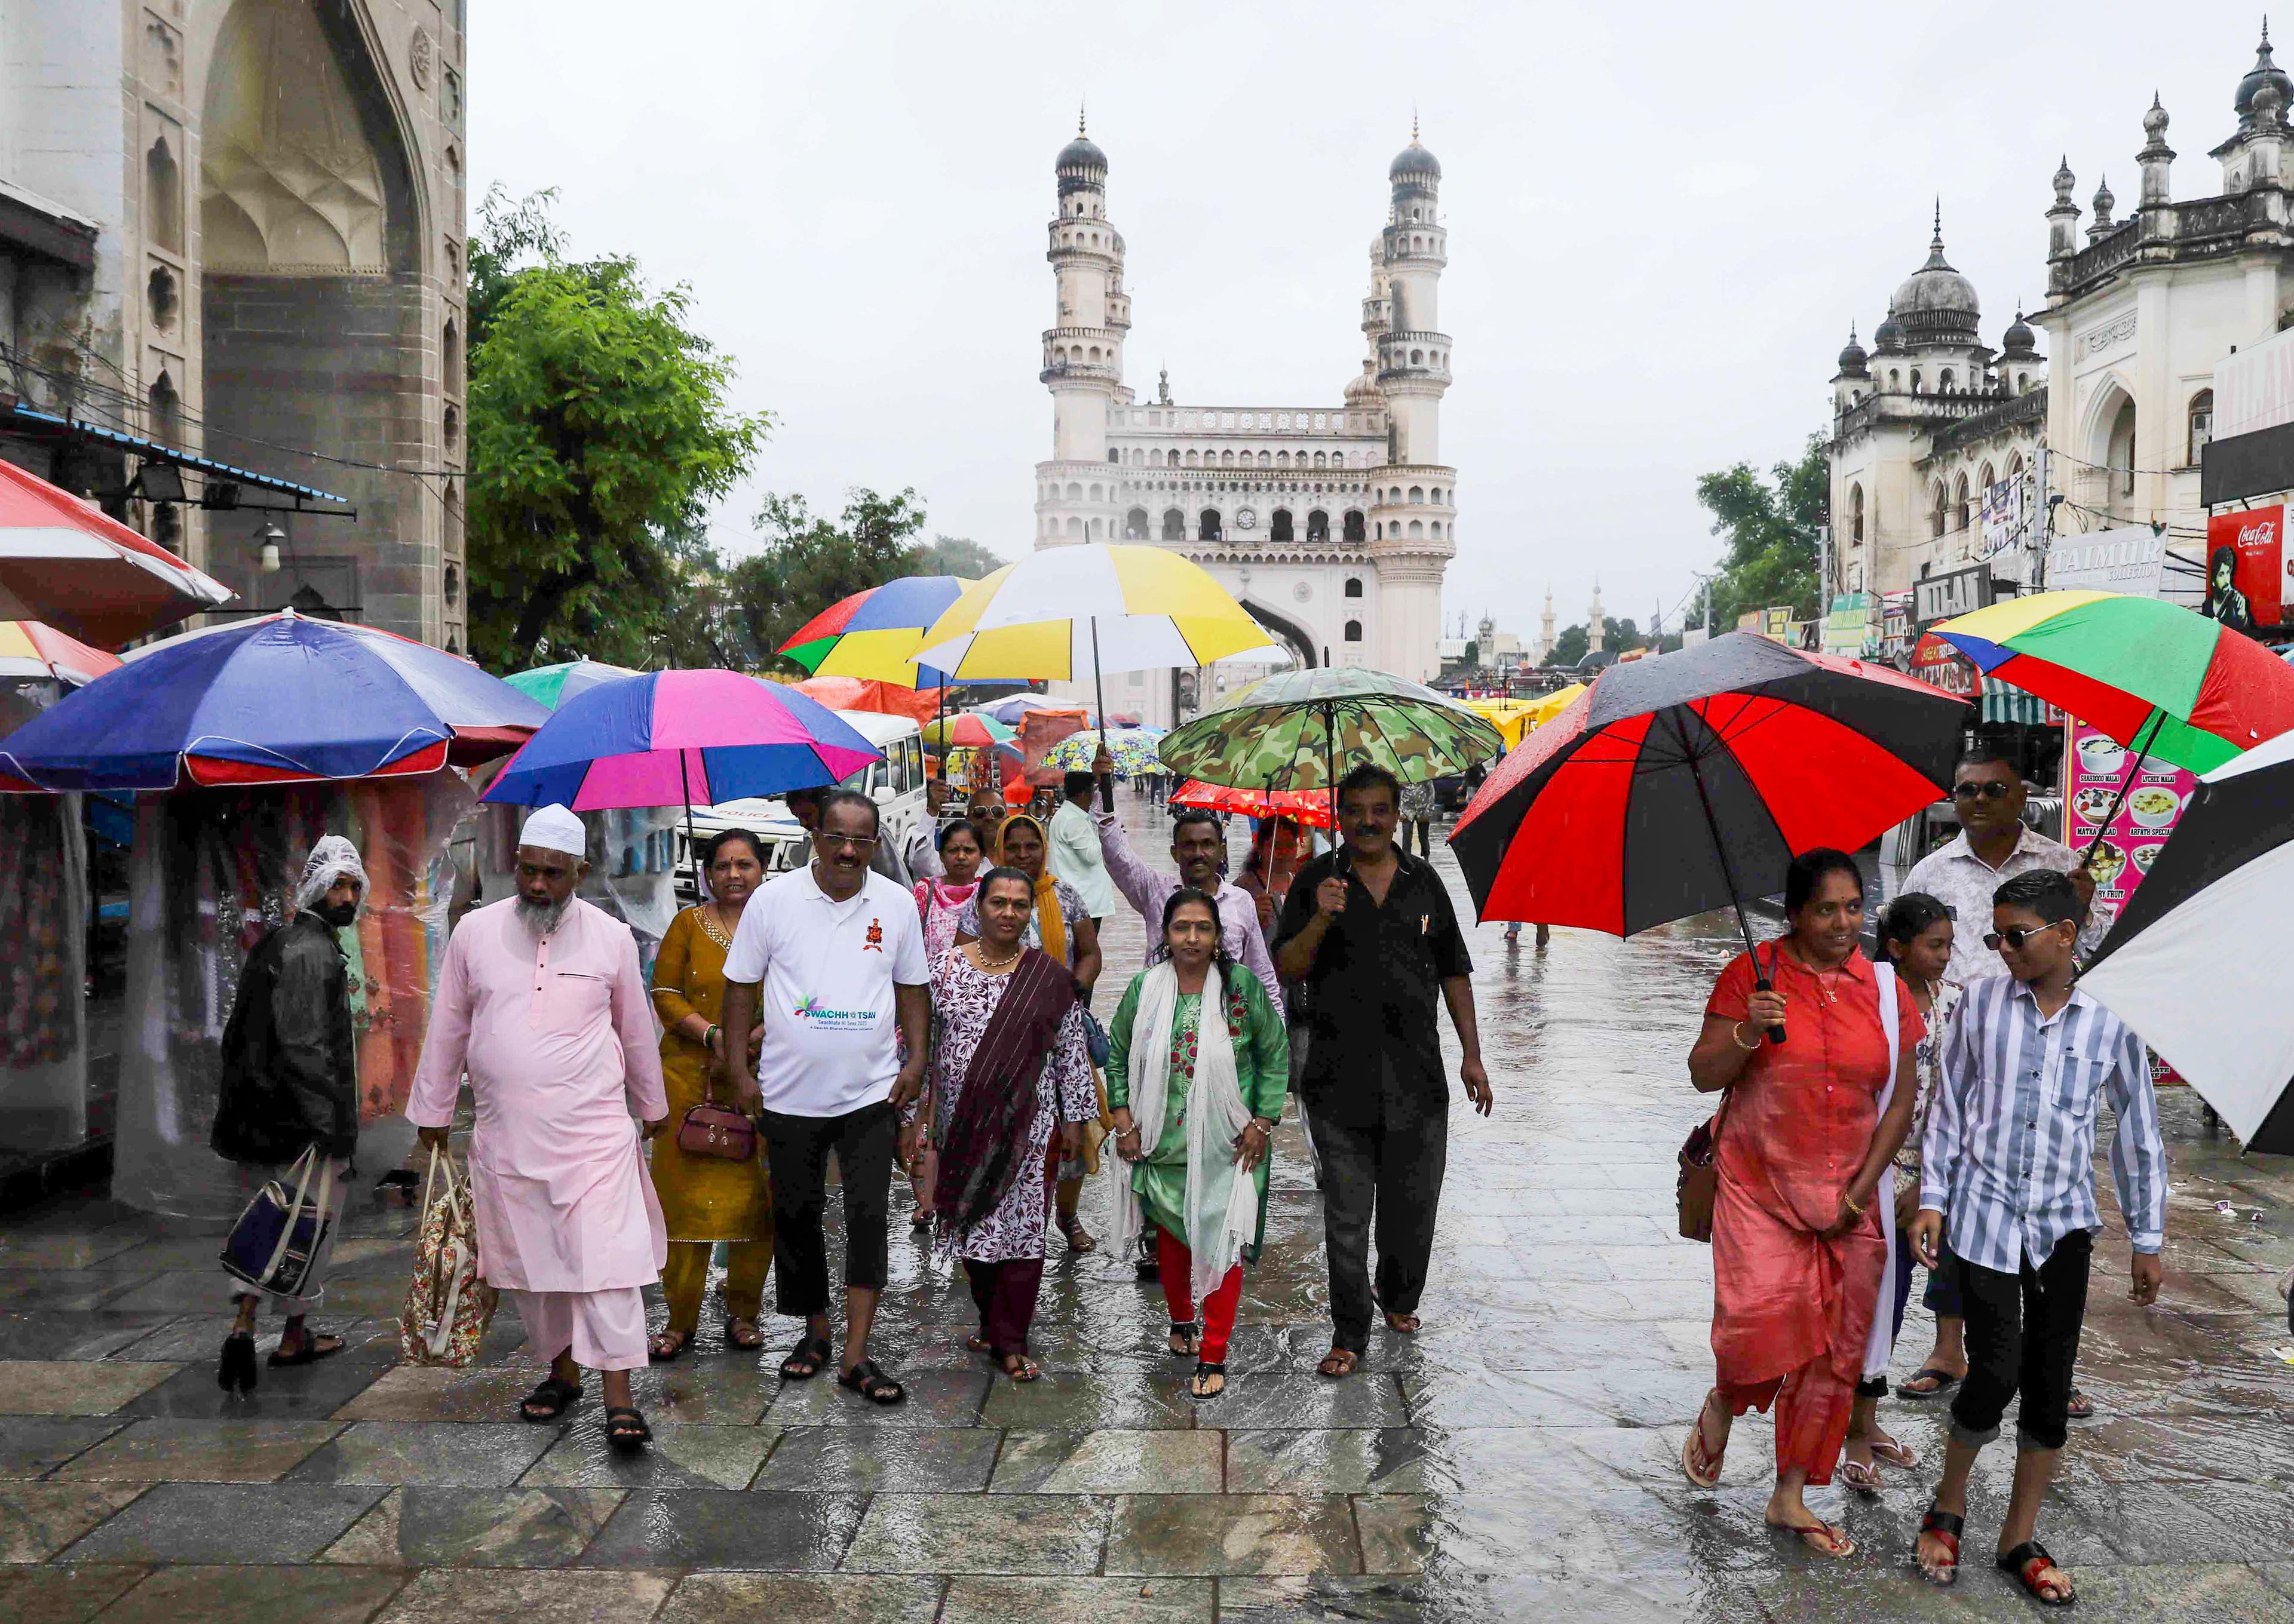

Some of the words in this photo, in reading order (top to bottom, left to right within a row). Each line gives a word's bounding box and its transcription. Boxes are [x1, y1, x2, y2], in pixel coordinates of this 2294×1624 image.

[2053, 538, 2161, 573] TAIMUR
[2108, 564, 2158, 581] COLLECTION
[2107, 890, 2124, 898] FRUIT
